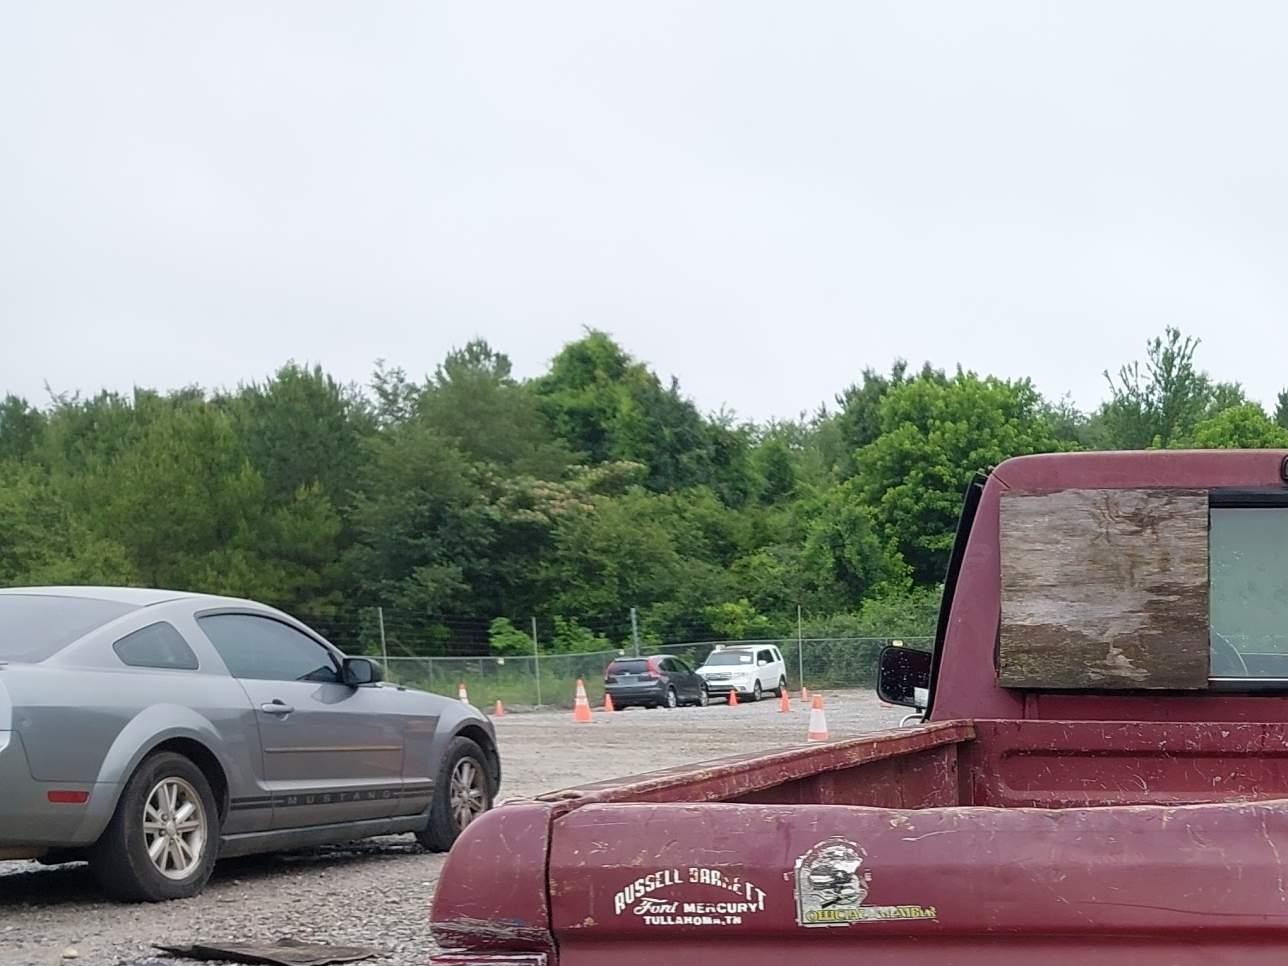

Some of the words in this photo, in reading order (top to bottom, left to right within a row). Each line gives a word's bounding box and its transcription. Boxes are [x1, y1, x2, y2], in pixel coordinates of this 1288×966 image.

[287, 791, 392, 805] MUSTANG
[614, 868, 685, 915] RUSSELL
[633, 897, 680, 915] Ford
[683, 902, 758, 914] MERCURY
